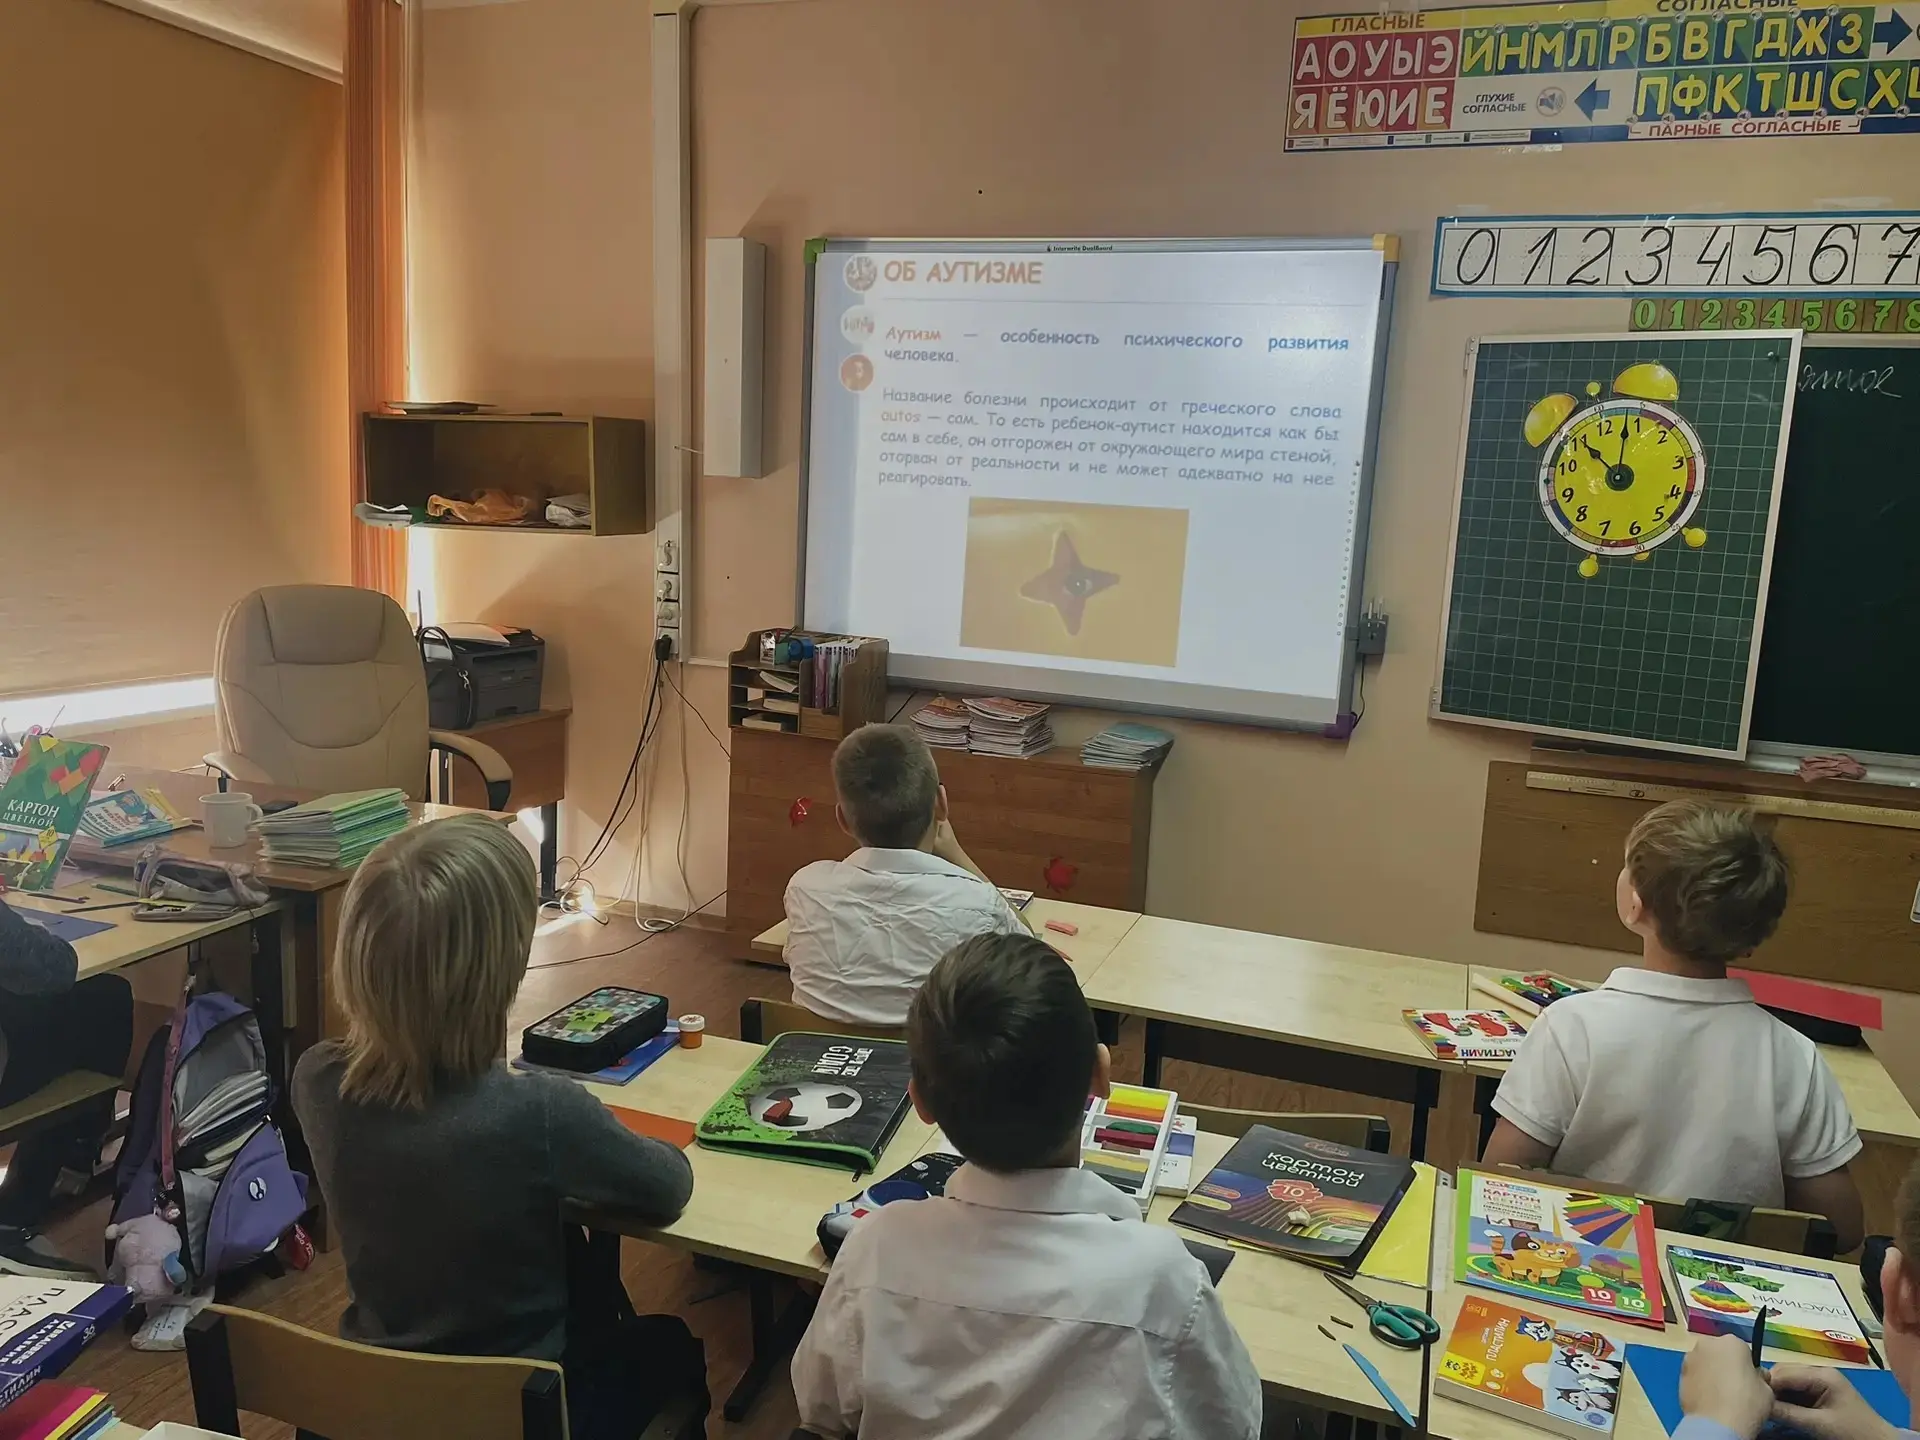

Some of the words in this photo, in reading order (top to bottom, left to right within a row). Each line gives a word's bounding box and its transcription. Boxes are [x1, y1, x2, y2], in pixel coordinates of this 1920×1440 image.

[1331, 14, 1426, 32] ГЛАСНЫЕ
[1475, 92, 1515, 103] ГЛУХИЕ
[1462, 103, 1527, 115] СОГЛАСНЫЕ
[1649, 123, 1722, 137] ПАРНЫЕ
[1731, 119, 1842, 134] СОГЛАСНЫЕ
[1457, 228, 1496, 285] 0
[1524, 227, 1557, 285] 1
[1566, 226, 1614, 285] 2
[1625, 226, 1673, 285] 3
[1696, 225, 1731, 286] 4
[1742, 224, 1796, 285] 5
[1808, 224, 1858, 285] 6
[1881, 224, 1920, 285] 7
[884, 260, 916, 283] ОБ
[926, 261, 1044, 285] АУТИЗМЕ
[1633, 299, 1658, 330] 0
[1668, 299, 1687, 330] 1
[1699, 299, 1724, 330] 2
[1732, 299, 1755, 330] 3
[1761, 299, 1787, 329] 4
[1801, 300, 1823, 332] 5
[1834, 299, 1857, 331] 6
[1873, 299, 1896, 331] 7
[886, 326, 942, 343] Аутизм
[1000, 328, 1100, 346] особенность
[1124, 333, 1243, 349] психического
[1267, 336, 1350, 352] развития
[884, 348, 960, 364] человека.
[882, 388, 953, 405] Название
[963, 390, 1027, 407] болезни
[1039, 395, 1137, 414] происходит
[1149, 400, 1168, 412] от
[1181, 401, 1276, 418] греческого
[1290, 405, 1342, 419] слова
[881, 409, 921, 424] autos
[946, 413, 979, 426] сам.
[986, 411, 1006, 427] То
[1012, 415, 1045, 429] есть
[1051, 415, 1175, 438] ребенок-аутист
[1182, 424, 1272, 440] находится
[1279, 428, 1307, 440] как
[1314, 428, 1340, 442] бы
[1596, 419, 1613, 437] 12
[1633, 417, 1641, 433] 1
[1657, 430, 1668, 445] 2
[880, 430, 908, 444] сам
[912, 432, 920, 444] в
[925, 430, 963, 448] себе,
[968, 435, 986, 447] он
[991, 436, 1073, 454] отгорожен
[1077, 441, 1097, 453] от
[1100, 441, 1216, 461] окружающего
[1220, 448, 1264, 467] мира
[1269, 448, 1337, 467] стеной,
[879, 451, 938, 467] оторван
[946, 454, 964, 466] от
[971, 455, 1060, 473] реальности
[1069, 461, 1080, 473] и
[1088, 463, 1108, 475] не
[1116, 464, 1168, 478] может
[1178, 466, 1263, 483] адекватно
[1273, 472, 1294, 484] на
[1303, 474, 1335, 486] нее
[1559, 458, 1577, 475] 10
[1672, 455, 1684, 470] 3
[878, 470, 972, 489] реагировать.
[1561, 487, 1575, 503] 9
[1669, 485, 1682, 500] 4
[1575, 505, 1589, 522] 8
[1652, 506, 1665, 522] 5
[1598, 520, 1612, 536] 7
[1629, 520, 1642, 536] 6
[7, 799, 60, 818] КАРТОН
[2, 812, 54, 827] ЦВЕТНОЙ
[811, 1045, 853, 1076] GOAL
[1261, 1159, 1360, 1188] цветной
[1267, 1152, 1365, 1181] картон
[1283, 1184, 1305, 1198] 10
[1483, 1187, 1541, 1204] КАРТОН
[1587, 1287, 1611, 1300] 10
[1621, 1296, 1645, 1308] 10
[0, 1287, 66, 1337] ПЛАС
[1752, 1293, 1848, 1317] ПЛАСТИЛИН
[1485, 1317, 1511, 1362] ПЛАСТИЛИН
